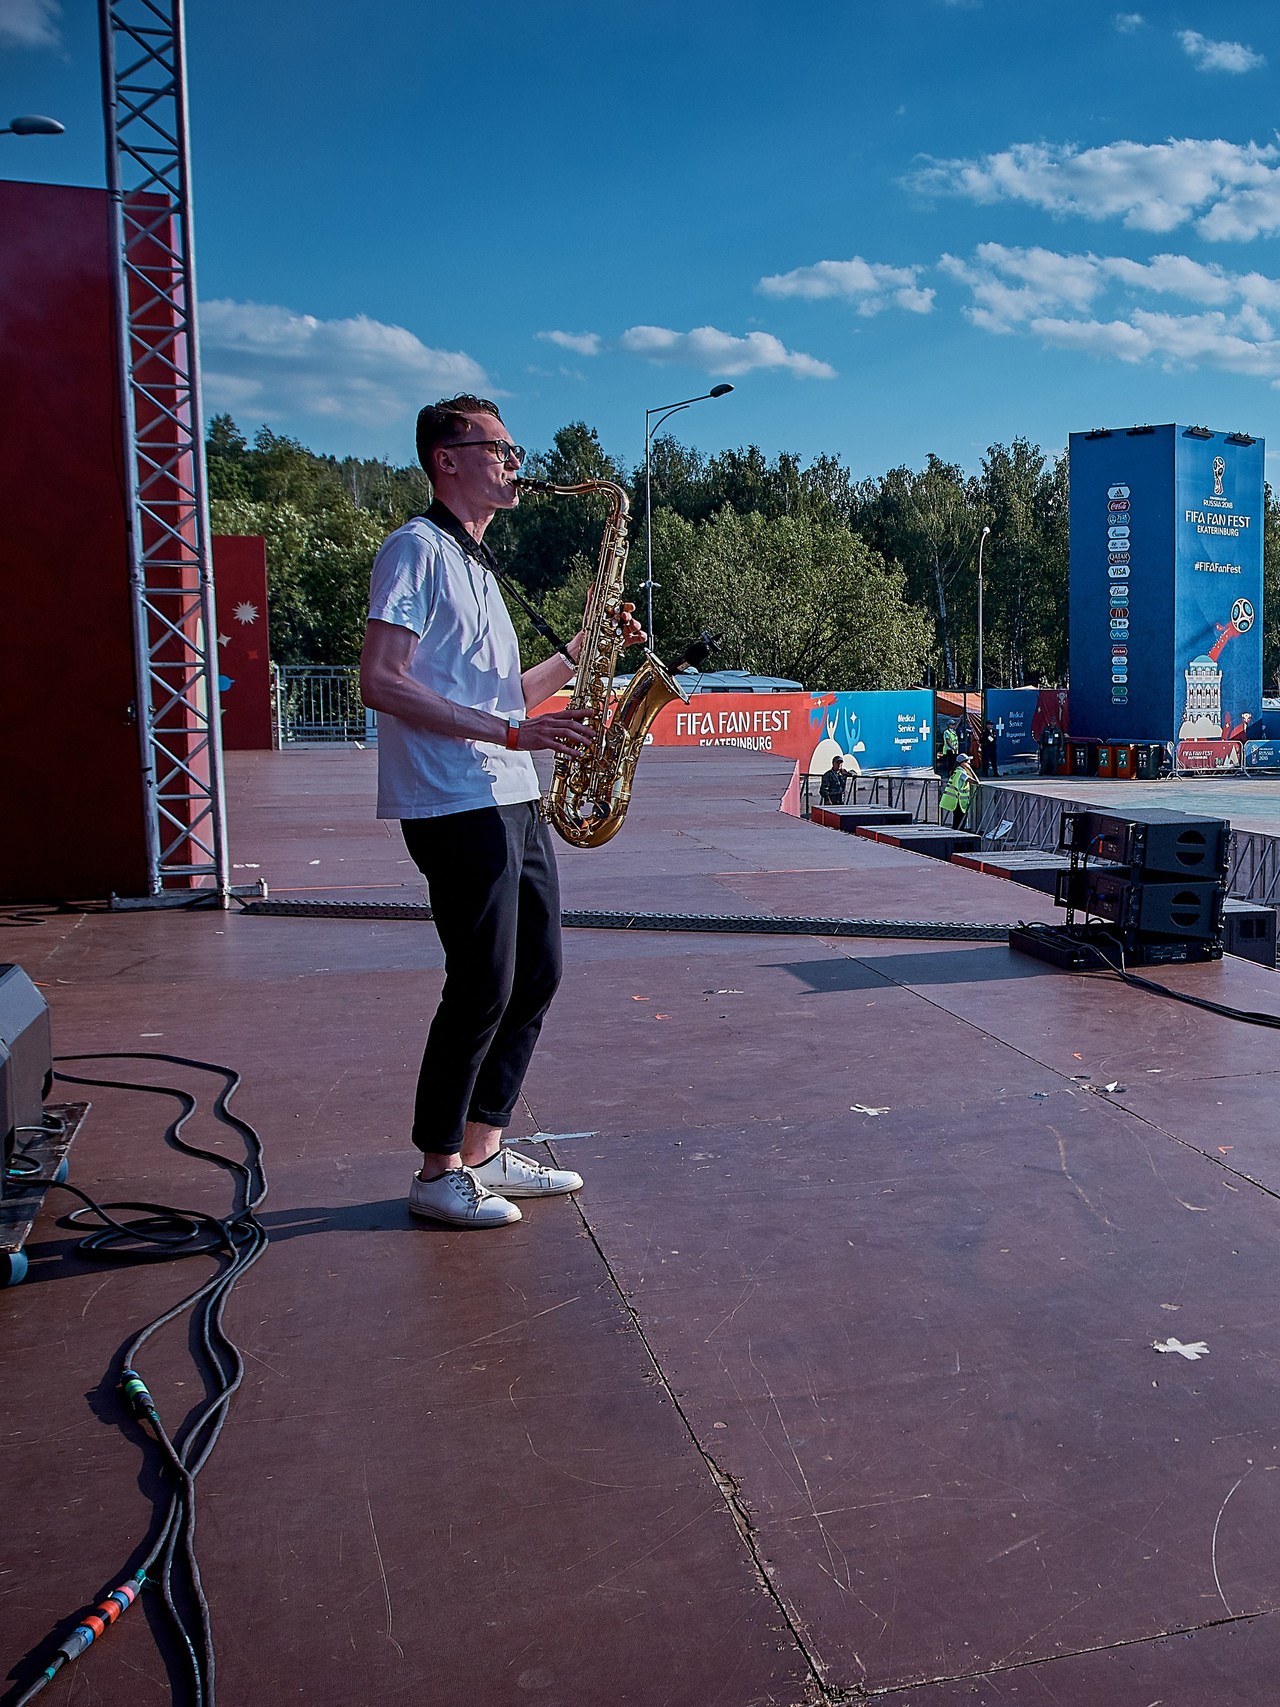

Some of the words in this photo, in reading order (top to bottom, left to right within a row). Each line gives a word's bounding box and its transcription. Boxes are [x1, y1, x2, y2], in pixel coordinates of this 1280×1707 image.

[1203, 499, 1221, 508] RUSSIA
[1185, 510, 1205, 524] FIFA
[1207, 513, 1226, 526] FAN
[1228, 515, 1250, 528] FEST
[1197, 525, 1239, 537] EKATERINBURG
[1194, 562, 1241, 574] #FIFAFanFest
[676, 712, 715, 736] FIFA
[719, 711, 750, 734] FAN
[754, 710, 791, 732] FEST
[898, 714, 916, 722] Medical
[898, 724, 915, 732] Service
